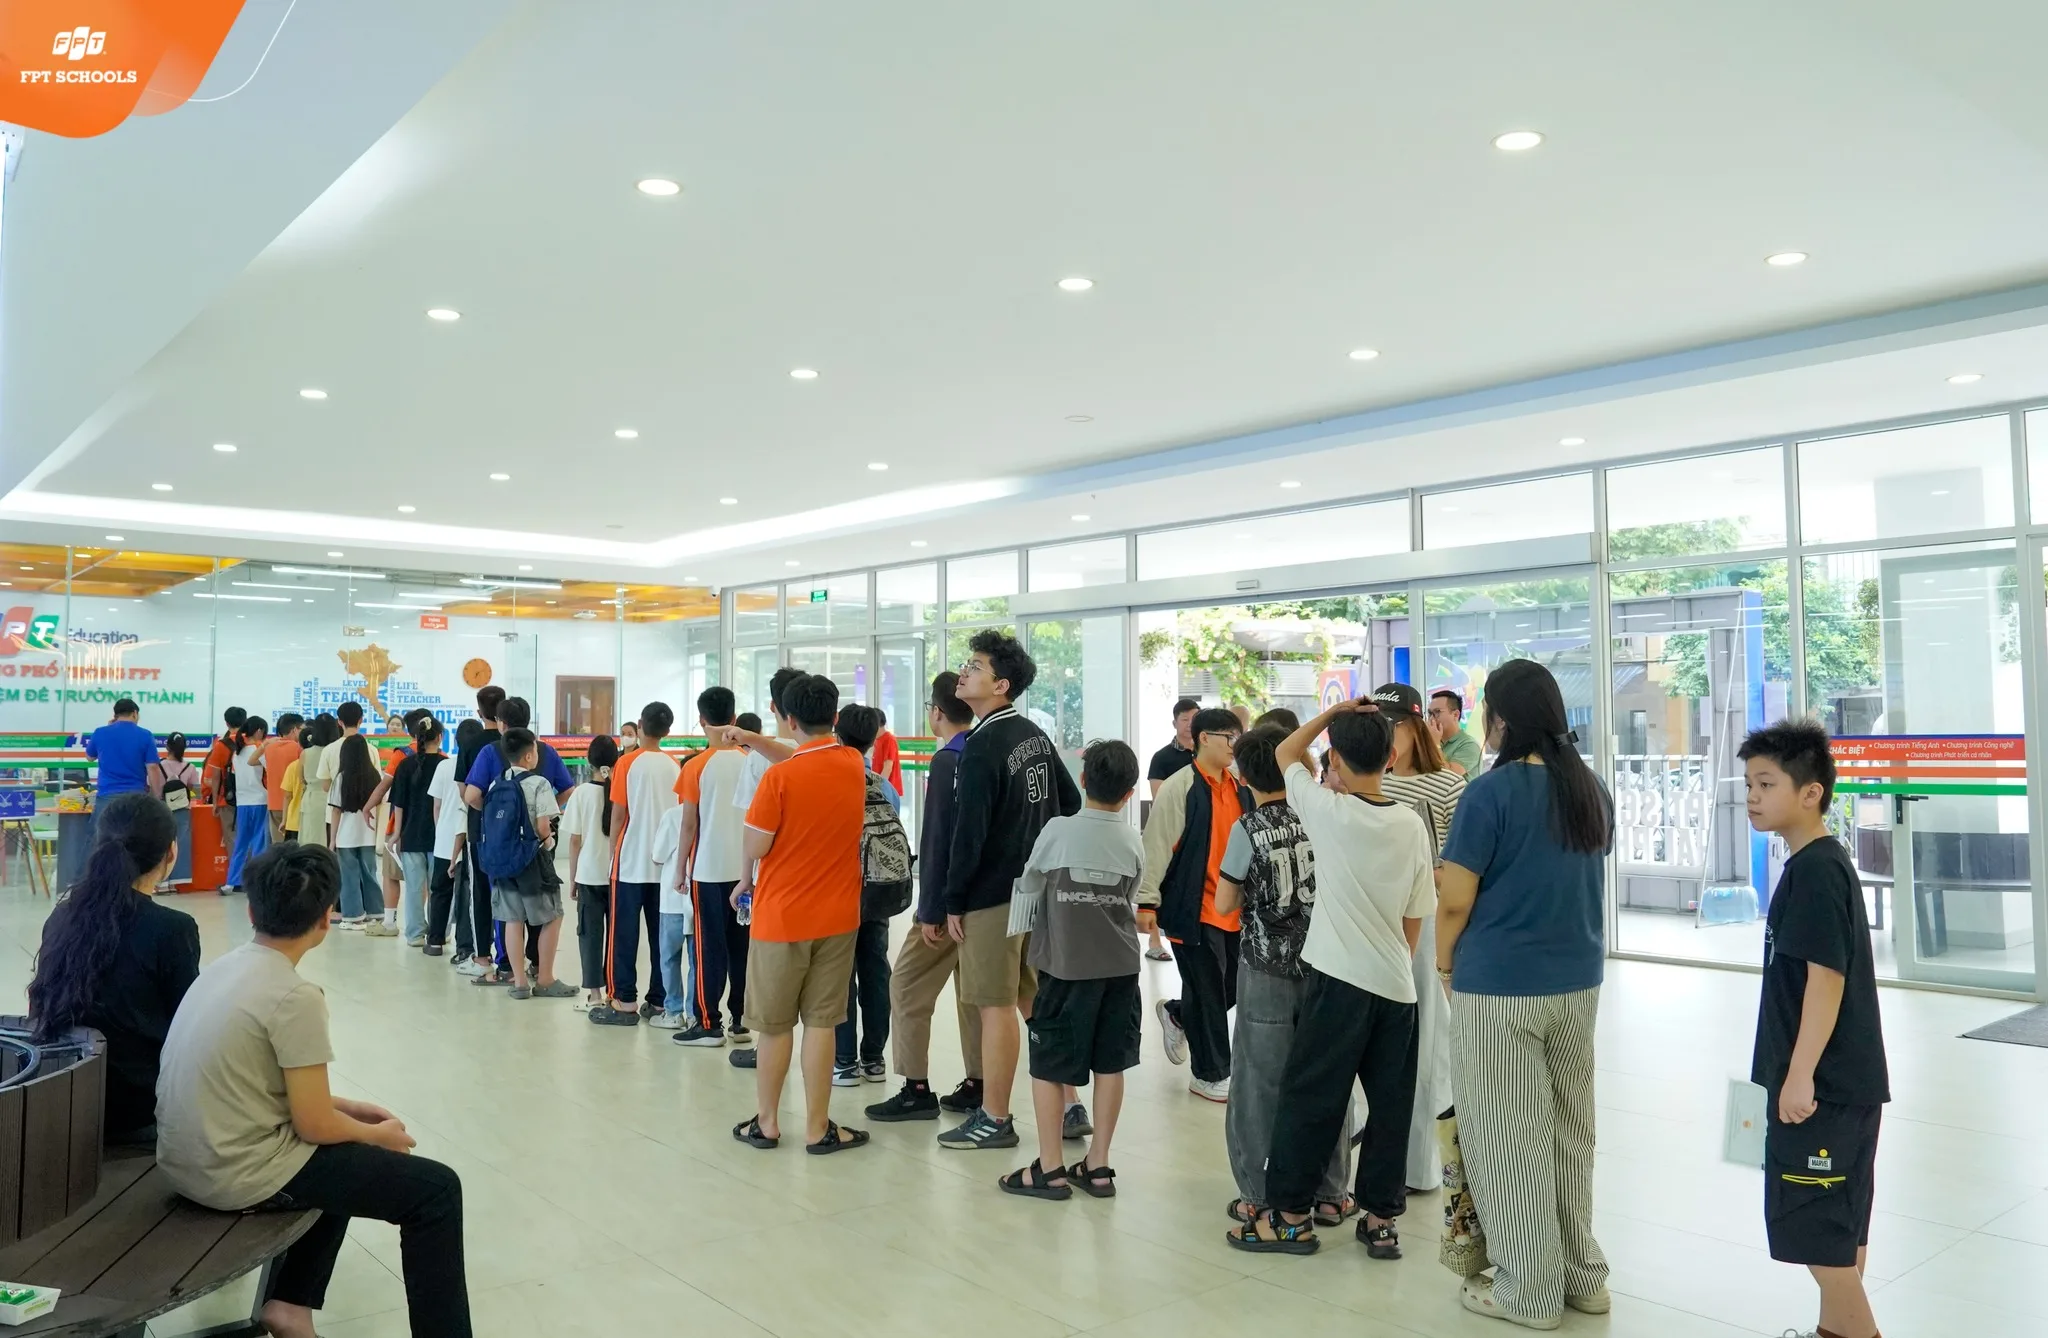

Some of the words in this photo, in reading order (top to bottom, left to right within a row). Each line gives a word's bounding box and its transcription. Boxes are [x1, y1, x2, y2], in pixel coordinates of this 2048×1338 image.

[69, 628, 138, 645] Education
[128, 668, 161, 680] FPT
[396, 682, 418, 690] LIFE
[137, 688, 194, 704] THÀNH
[396, 695, 441, 703] TEACHER
[454, 709, 473, 717] LIFE
[1007, 736, 1041, 776] SPEED
[1848, 743, 1866, 756] BIỆT
[1026, 762, 1049, 803] 97
[1252, 826, 1289, 847] Minh
[1289, 822, 1304, 837] Tr
